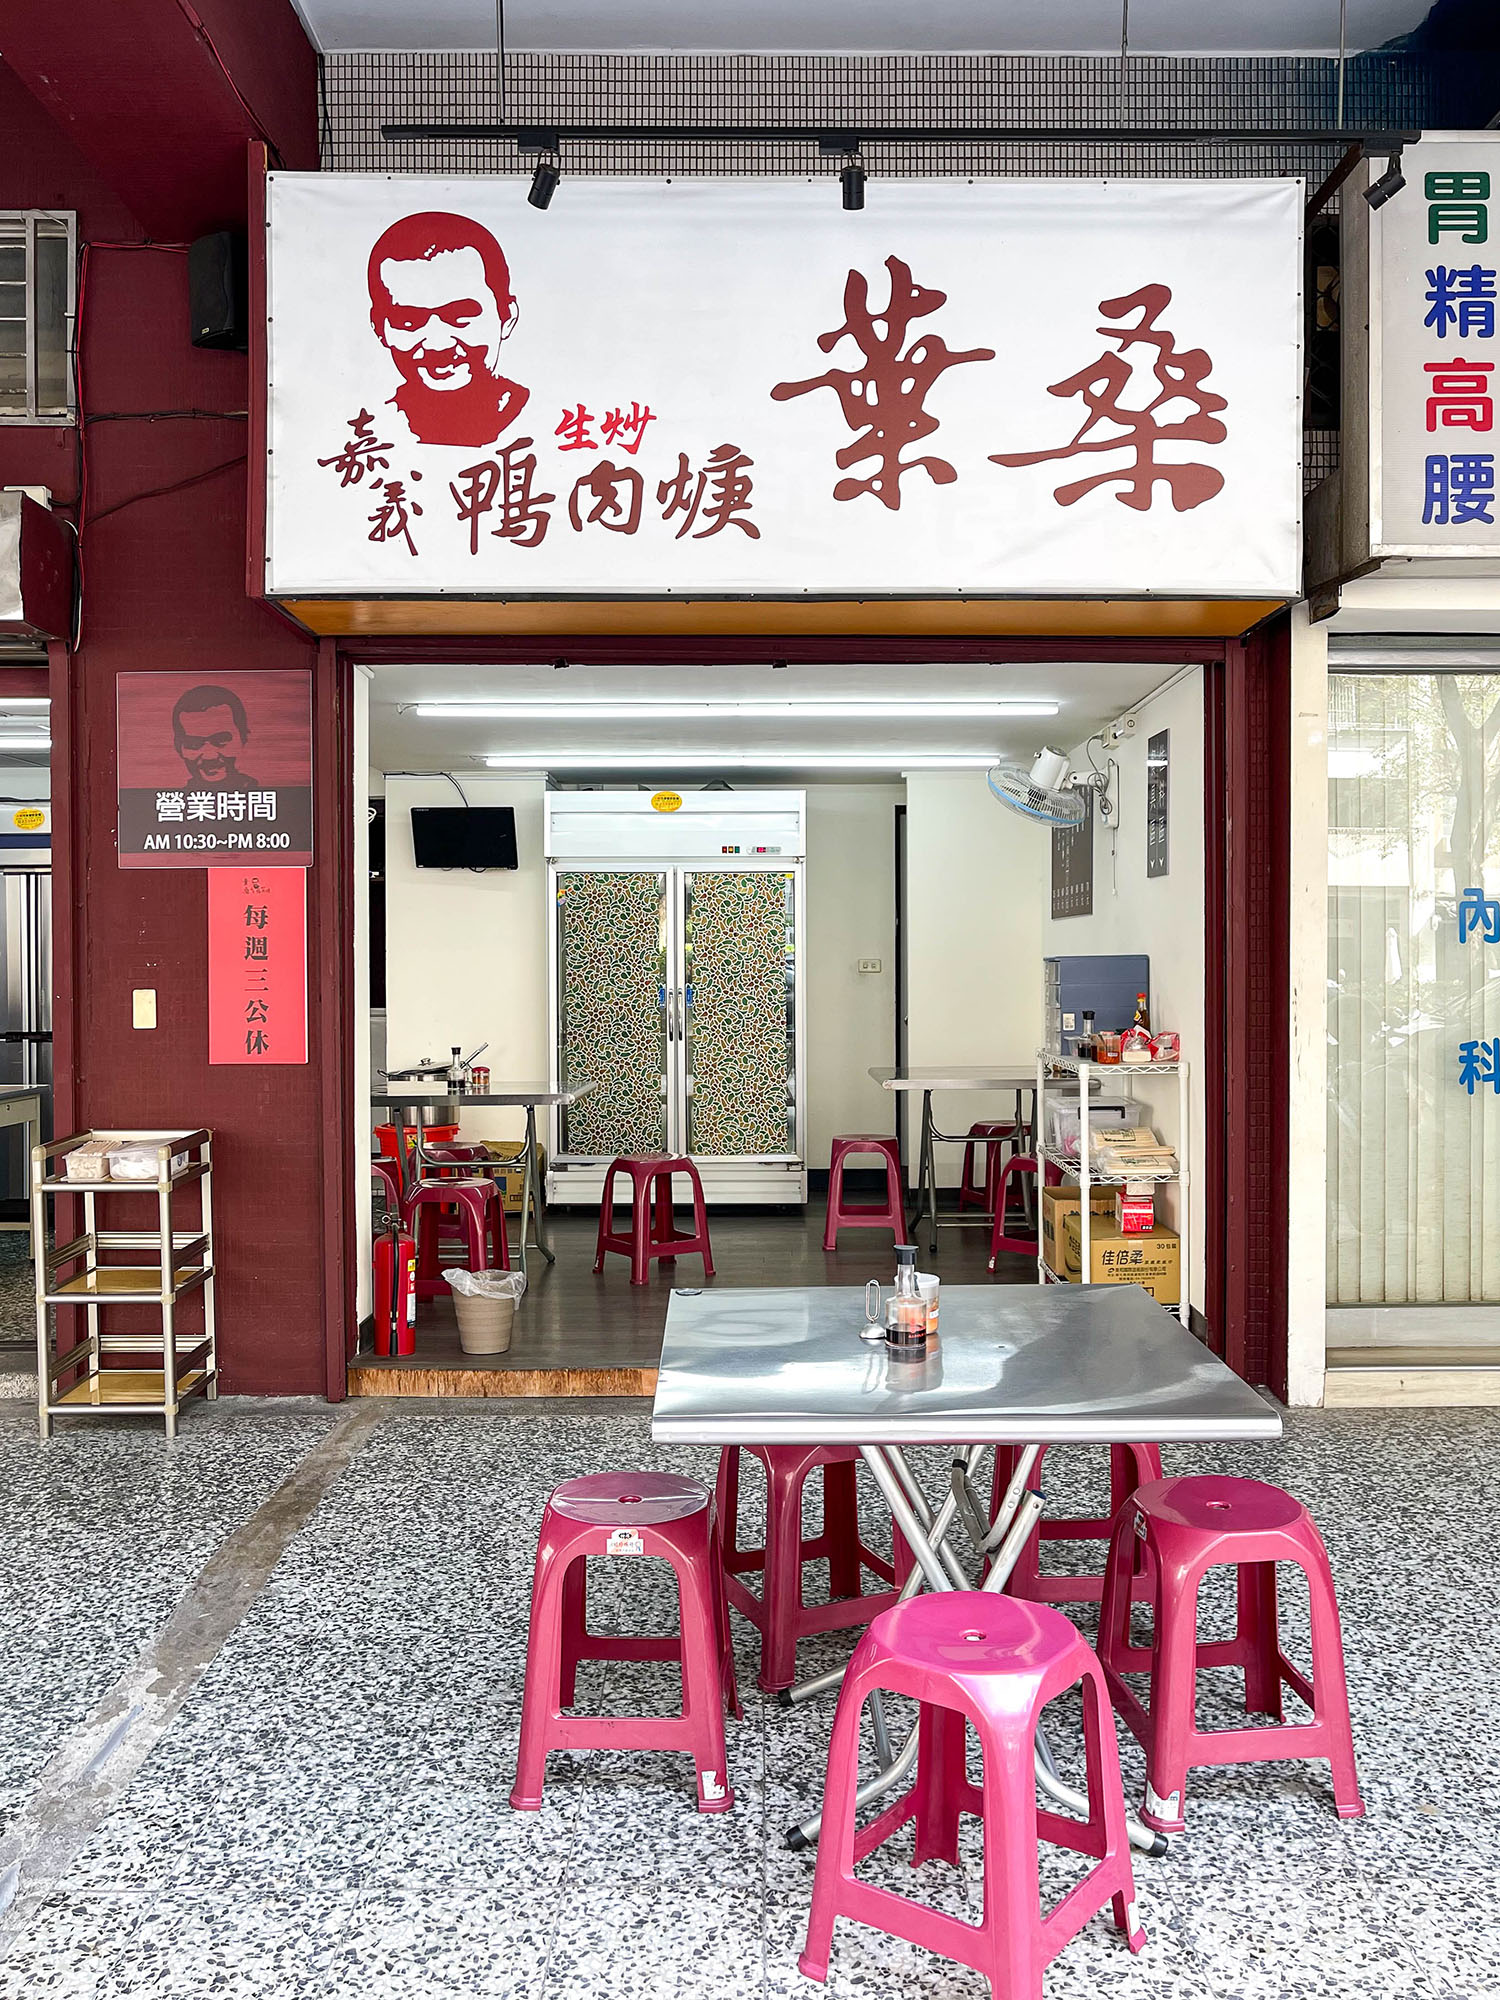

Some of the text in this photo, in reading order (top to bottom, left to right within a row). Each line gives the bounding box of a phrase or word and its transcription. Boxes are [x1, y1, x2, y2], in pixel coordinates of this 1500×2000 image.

[554, 401, 657, 455] 生炒
[317, 408, 424, 557] 嘉義
[155, 791, 277, 822] 營業時間
[144, 834, 170, 850] AM
[256, 833, 290, 849] 8:00
[244, 904, 270, 1056] 每週三公休
[1101, 1249, 1144, 1266] 佳倍柔
